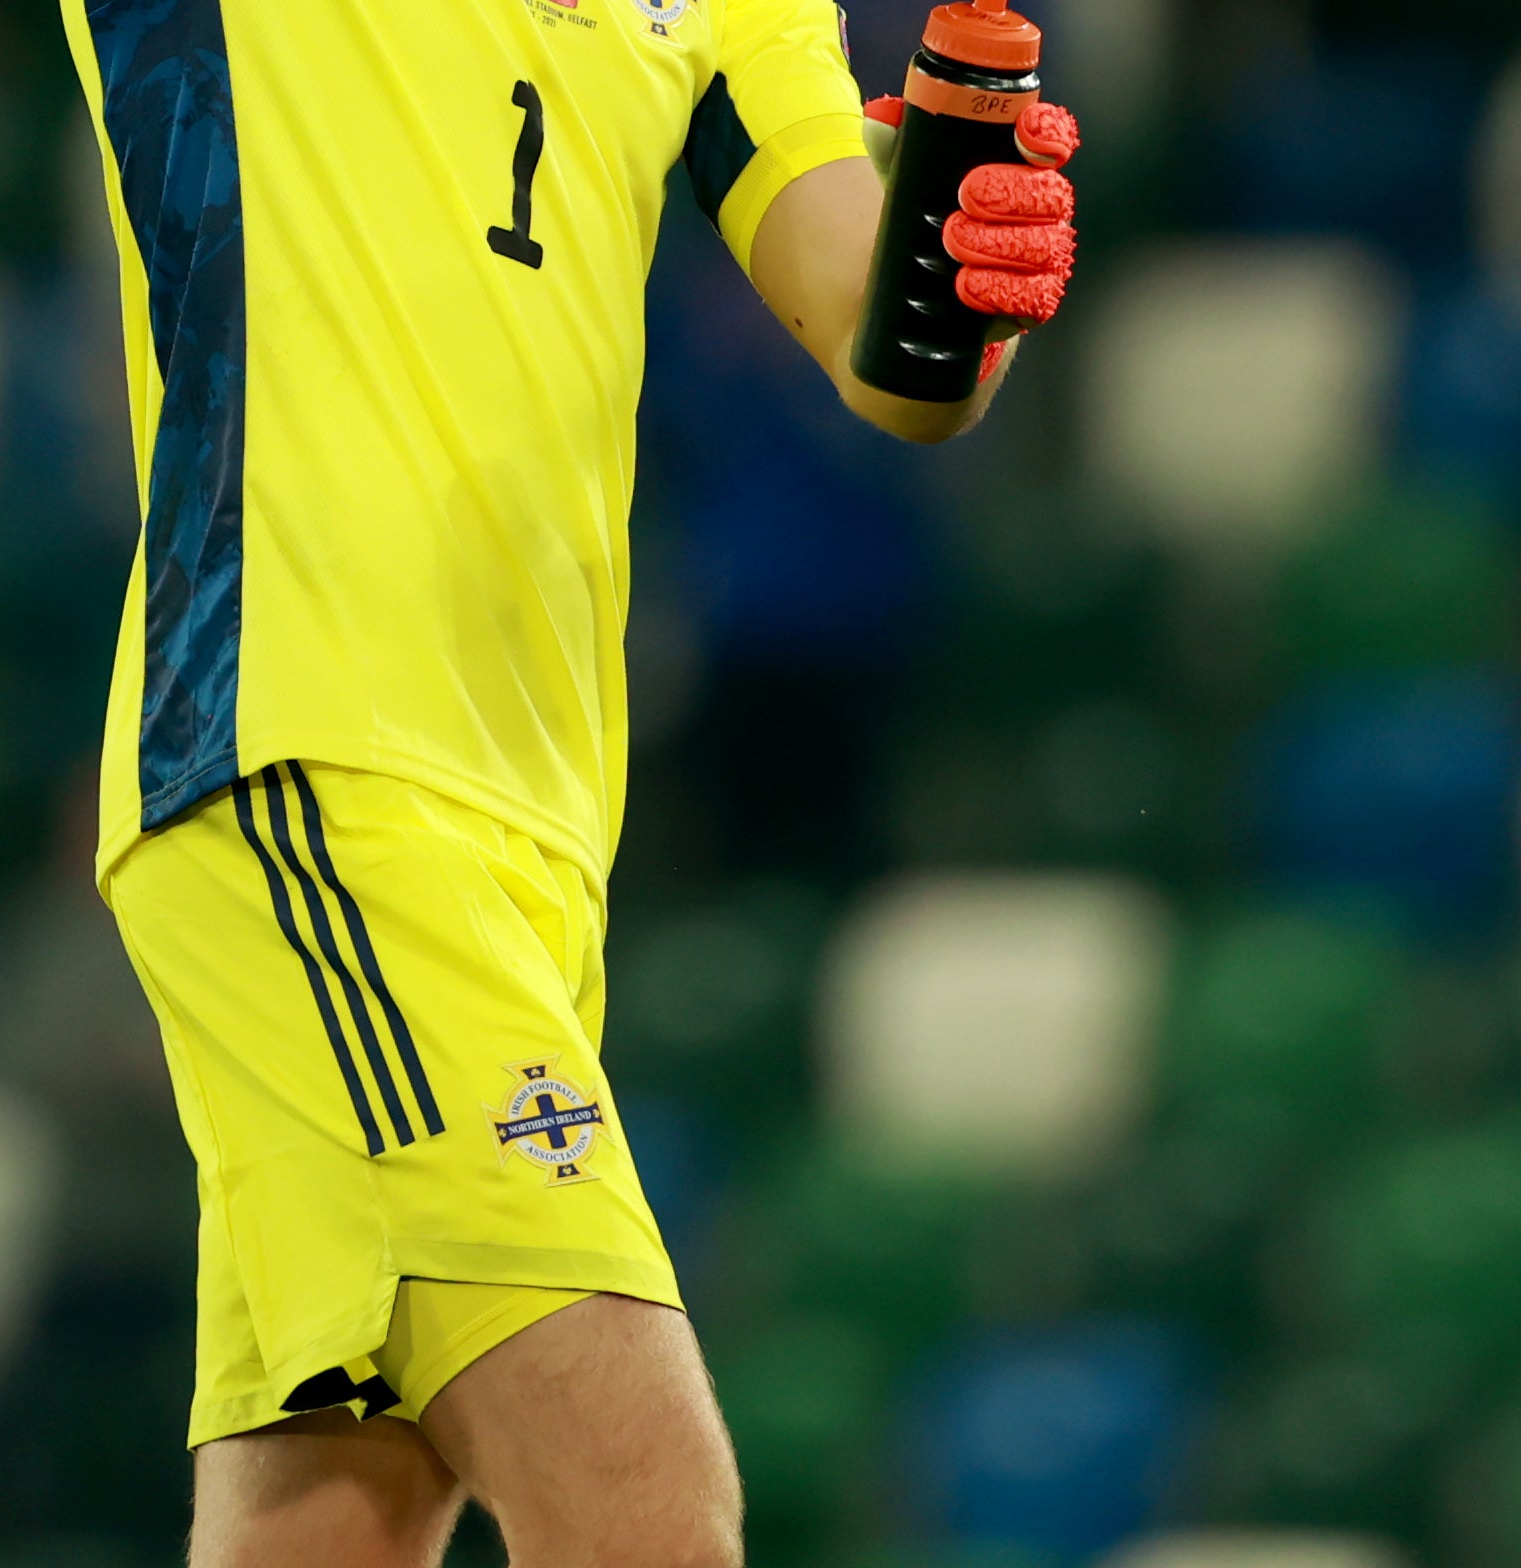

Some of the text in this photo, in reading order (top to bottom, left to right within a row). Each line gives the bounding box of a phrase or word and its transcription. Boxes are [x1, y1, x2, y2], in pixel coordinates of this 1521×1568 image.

[567, 13, 598, 30] BELFAST
[486, 79, 544, 271] 1
[511, 1081, 577, 1116] IRISH FOOTBALL
[508, 1110, 592, 1136] NORTHERN IRELAND
[527, 1134, 588, 1162] ASSOCIATION
